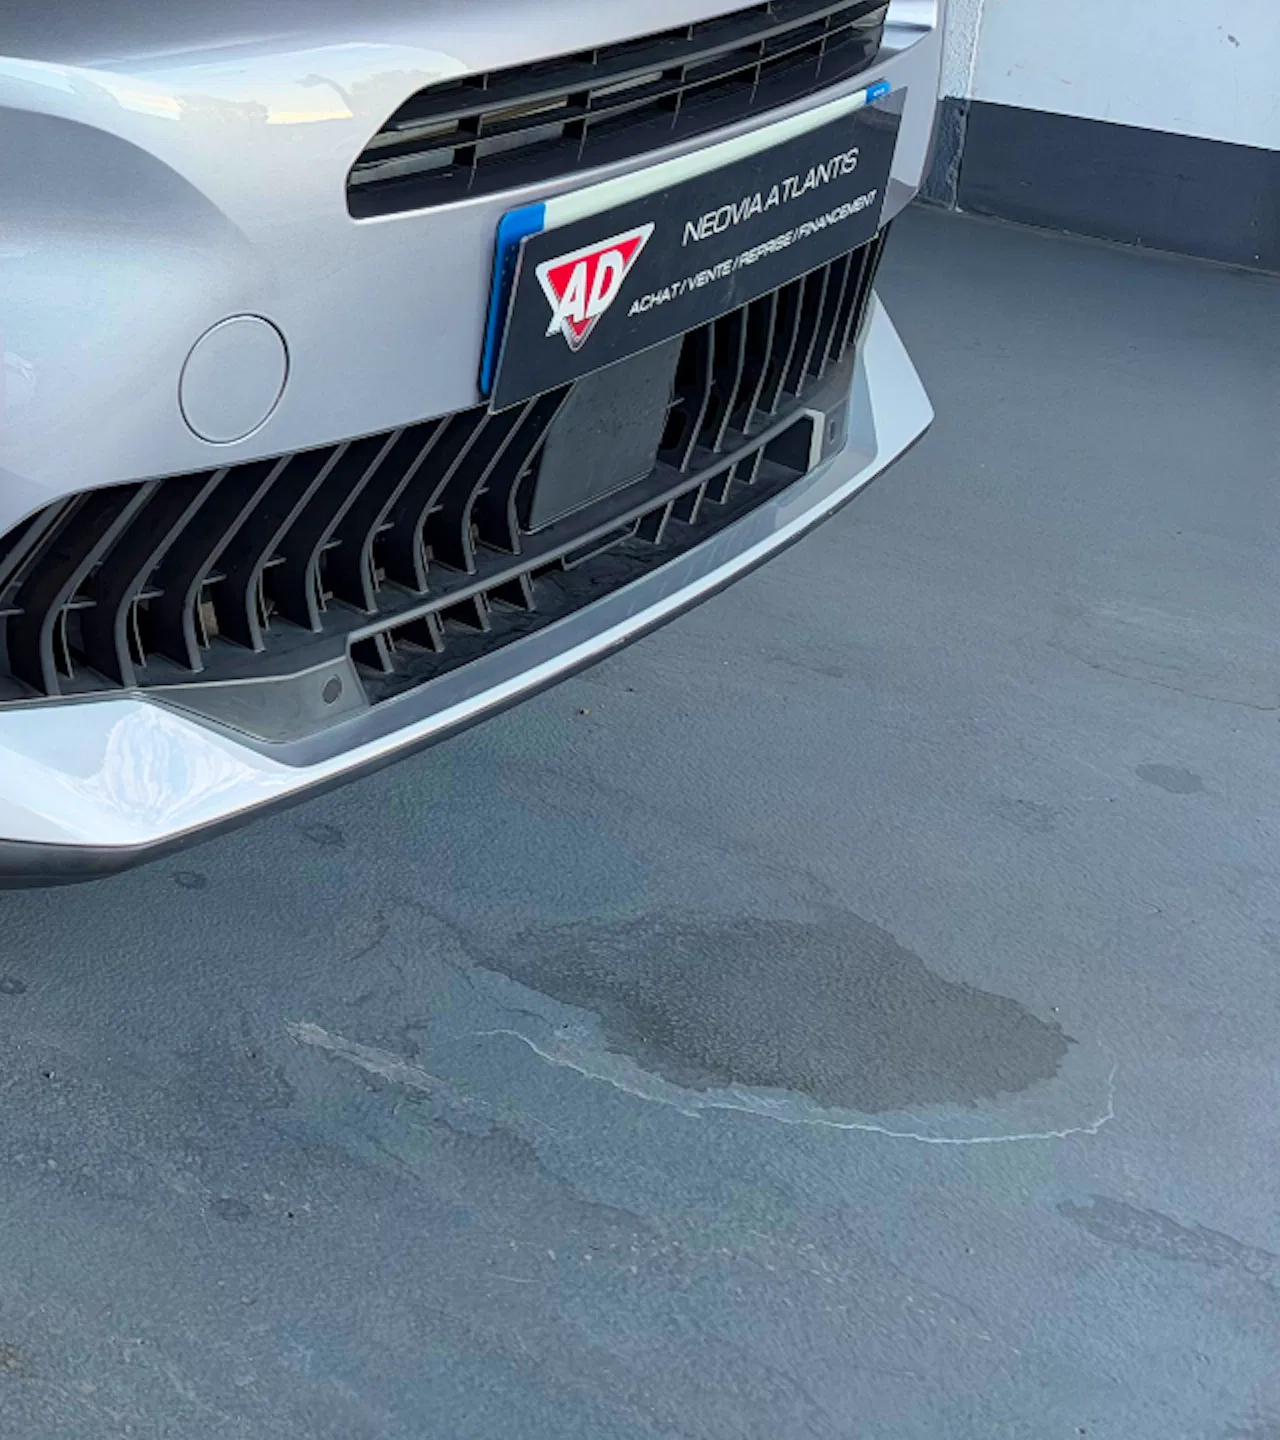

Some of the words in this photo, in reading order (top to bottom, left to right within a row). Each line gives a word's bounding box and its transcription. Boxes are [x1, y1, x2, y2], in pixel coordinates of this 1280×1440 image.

[681, 192, 763, 248] NEOVIA
[763, 146, 859, 212] ATLANTIS
[545, 249, 624, 337] AD
